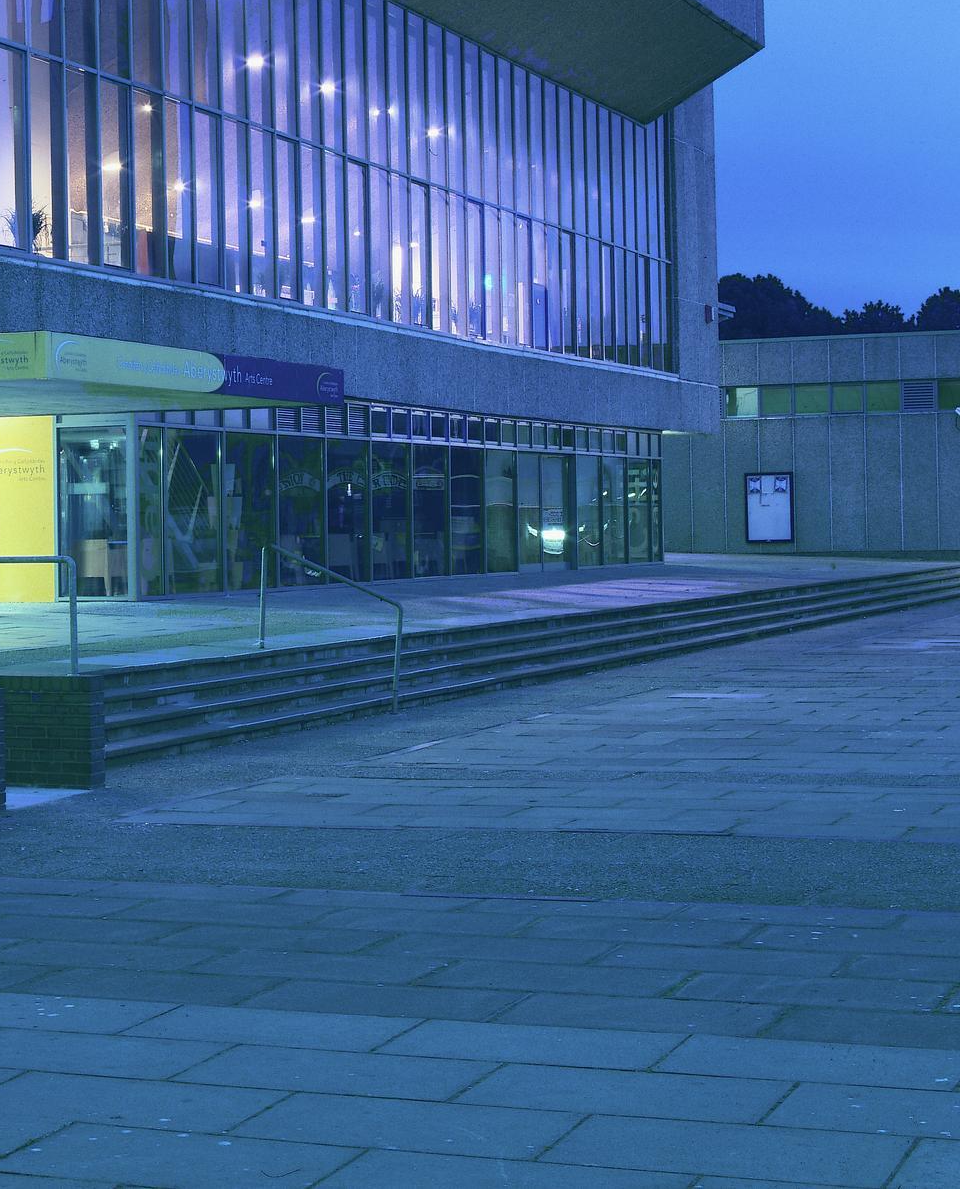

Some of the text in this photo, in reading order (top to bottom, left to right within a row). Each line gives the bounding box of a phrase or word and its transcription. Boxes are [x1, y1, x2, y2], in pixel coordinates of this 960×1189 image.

[183, 360, 242, 387] Aberystwyth
[244, 372, 256, 384] Arts
[256, 373, 273, 386] Centre
